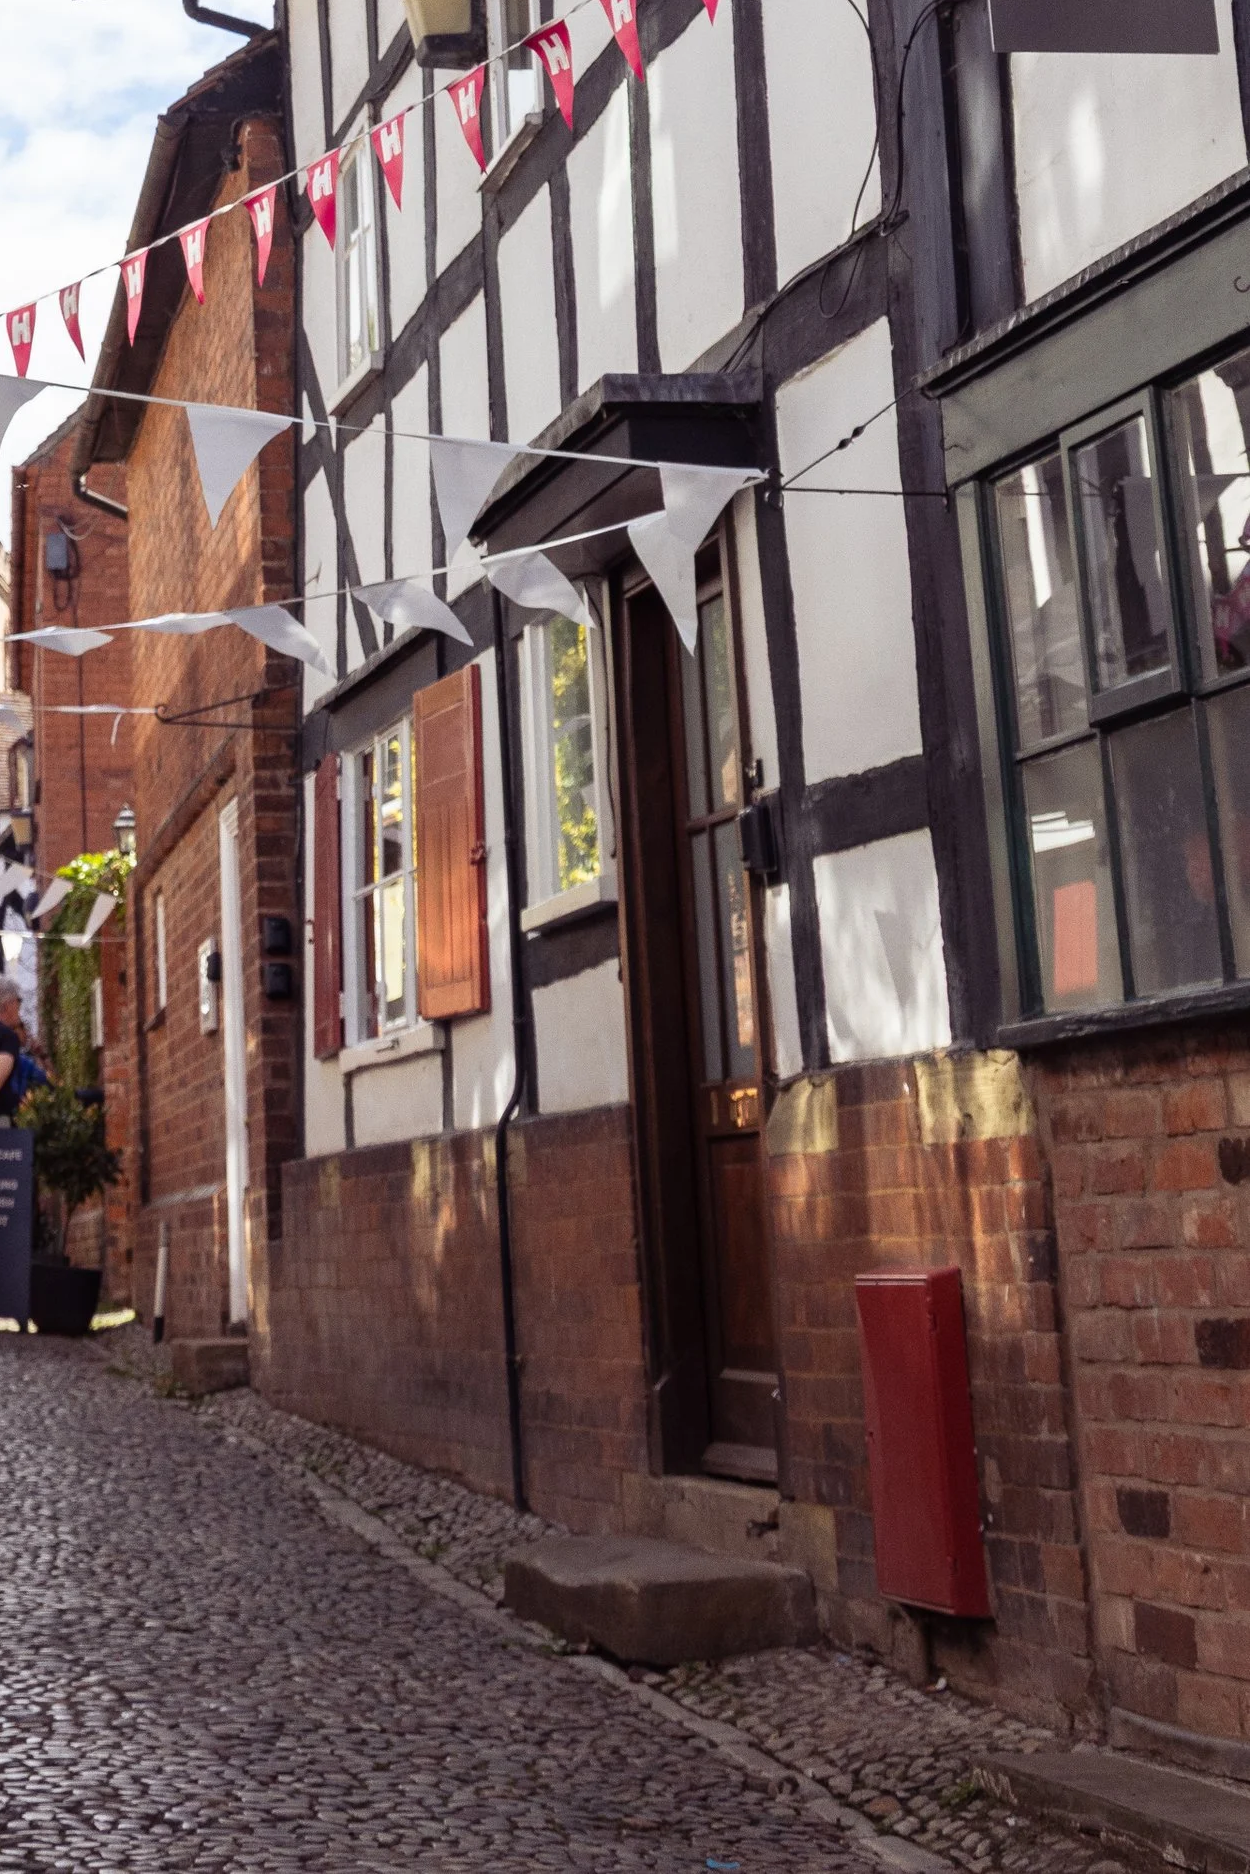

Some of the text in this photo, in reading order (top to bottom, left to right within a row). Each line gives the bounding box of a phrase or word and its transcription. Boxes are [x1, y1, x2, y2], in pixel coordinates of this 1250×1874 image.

[539, 32, 570, 75] H
[458, 80, 476, 124] H
[380, 119, 401, 164] H
[313, 160, 333, 201] H
[254, 197, 271, 238] H
[187, 229, 201, 269] H
[127, 261, 141, 299] H
[63, 286, 78, 320] H
[12, 311, 31, 346] H
